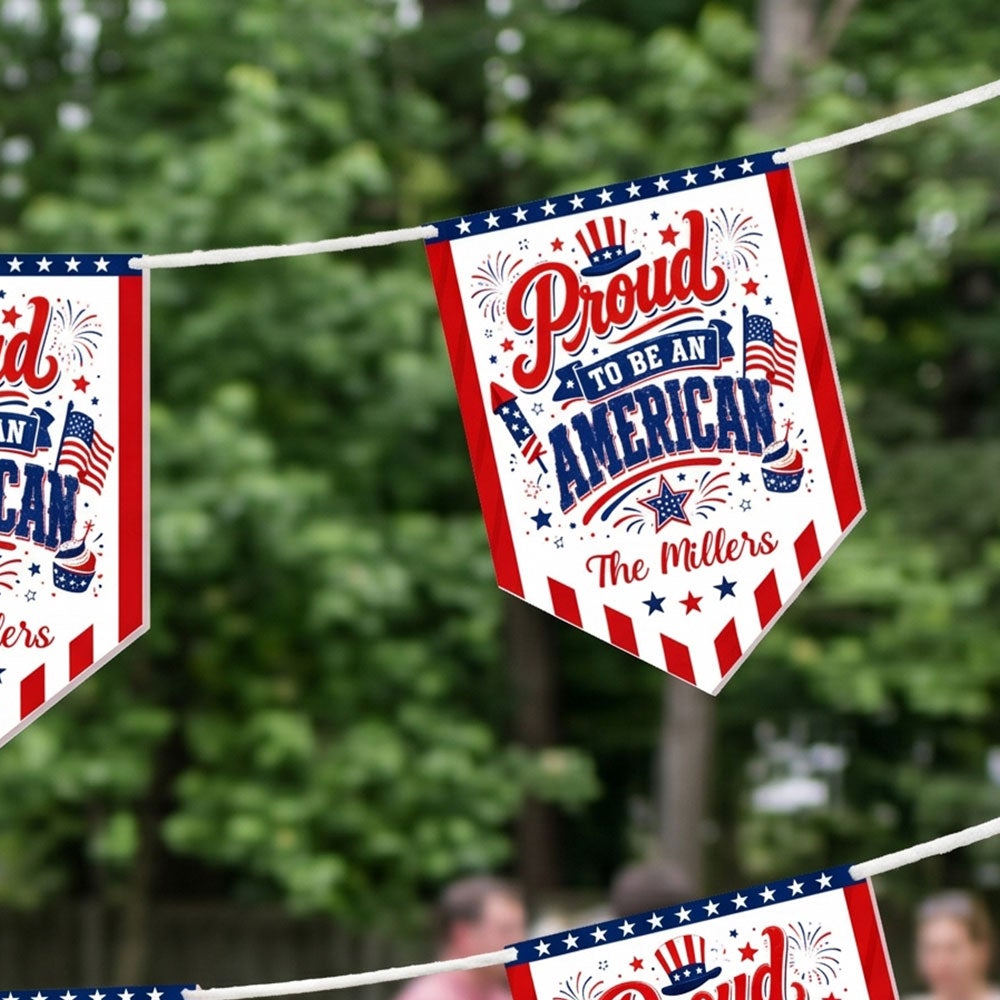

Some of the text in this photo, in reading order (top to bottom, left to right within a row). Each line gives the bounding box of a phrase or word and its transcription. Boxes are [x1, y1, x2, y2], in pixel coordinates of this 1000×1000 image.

[507, 209, 728, 393] Proud
[588, 335, 706, 392] TO BE AN
[547, 375, 776, 513] AMERICAN
[586, 527, 779, 587] The Millers
